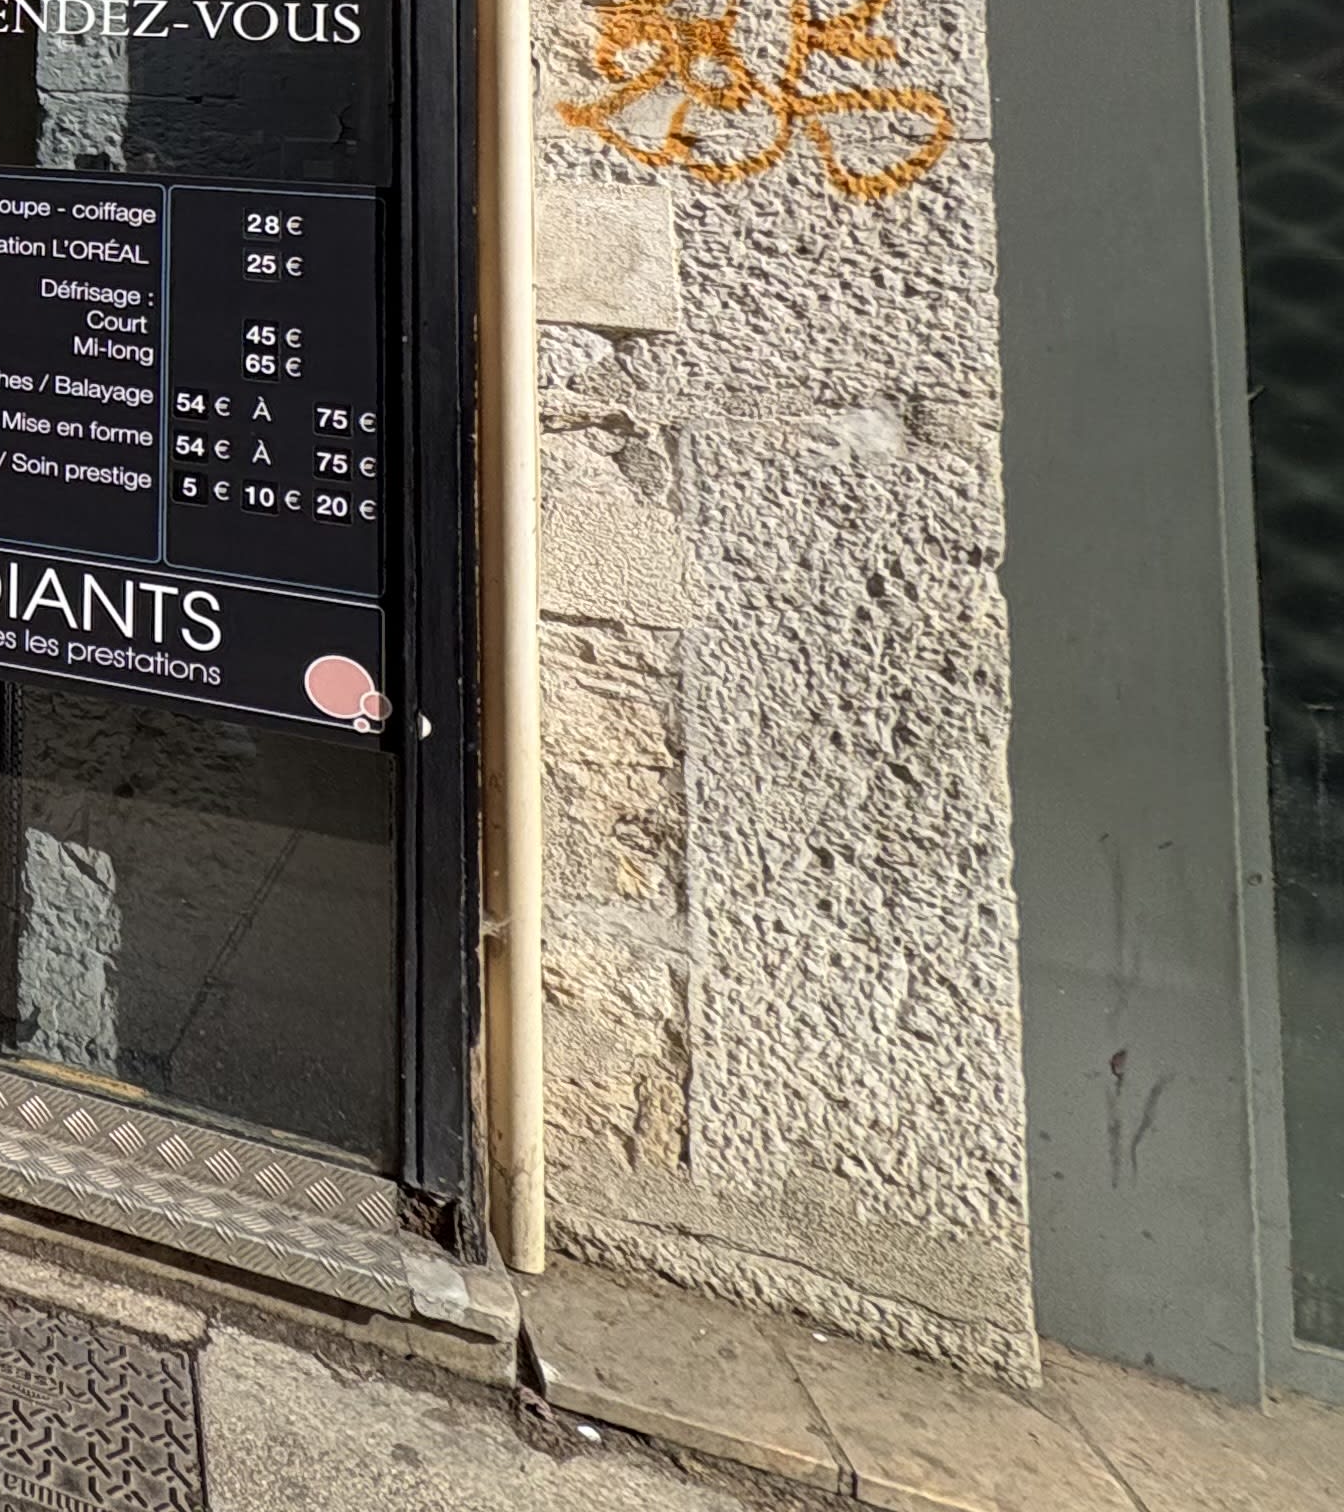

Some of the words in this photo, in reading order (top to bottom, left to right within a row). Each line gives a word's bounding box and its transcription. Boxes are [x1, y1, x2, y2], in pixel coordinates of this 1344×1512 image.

[71, 201, 157, 227] coiffage
[247, 213, 281, 235] 28
[52, 238, 150, 265] L'ORÉAL
[246, 253, 277, 274] 25
[41, 278, 141, 309] Défrisage
[86, 309, 148, 334] Court
[245, 325, 276, 346] 45
[73, 335, 154, 367] Mi-long
[245, 353, 276, 375] 65
[55, 375, 154, 407] Balayage
[176, 392, 206, 414] 54
[316, 407, 348, 430] 75
[2, 410, 51, 434] Mise
[56, 421, 83, 438] en
[89, 420, 154, 447] forme
[175, 435, 205, 457] 54
[316, 451, 348, 474] 75
[11, 452, 59, 477] Soin
[65, 463, 152, 492] prestige
[182, 477, 198, 497] 5
[244, 485, 275, 508] 10
[316, 494, 348, 517] 20
[24, 628, 59, 657] les
[67, 641, 221, 685] prestations
